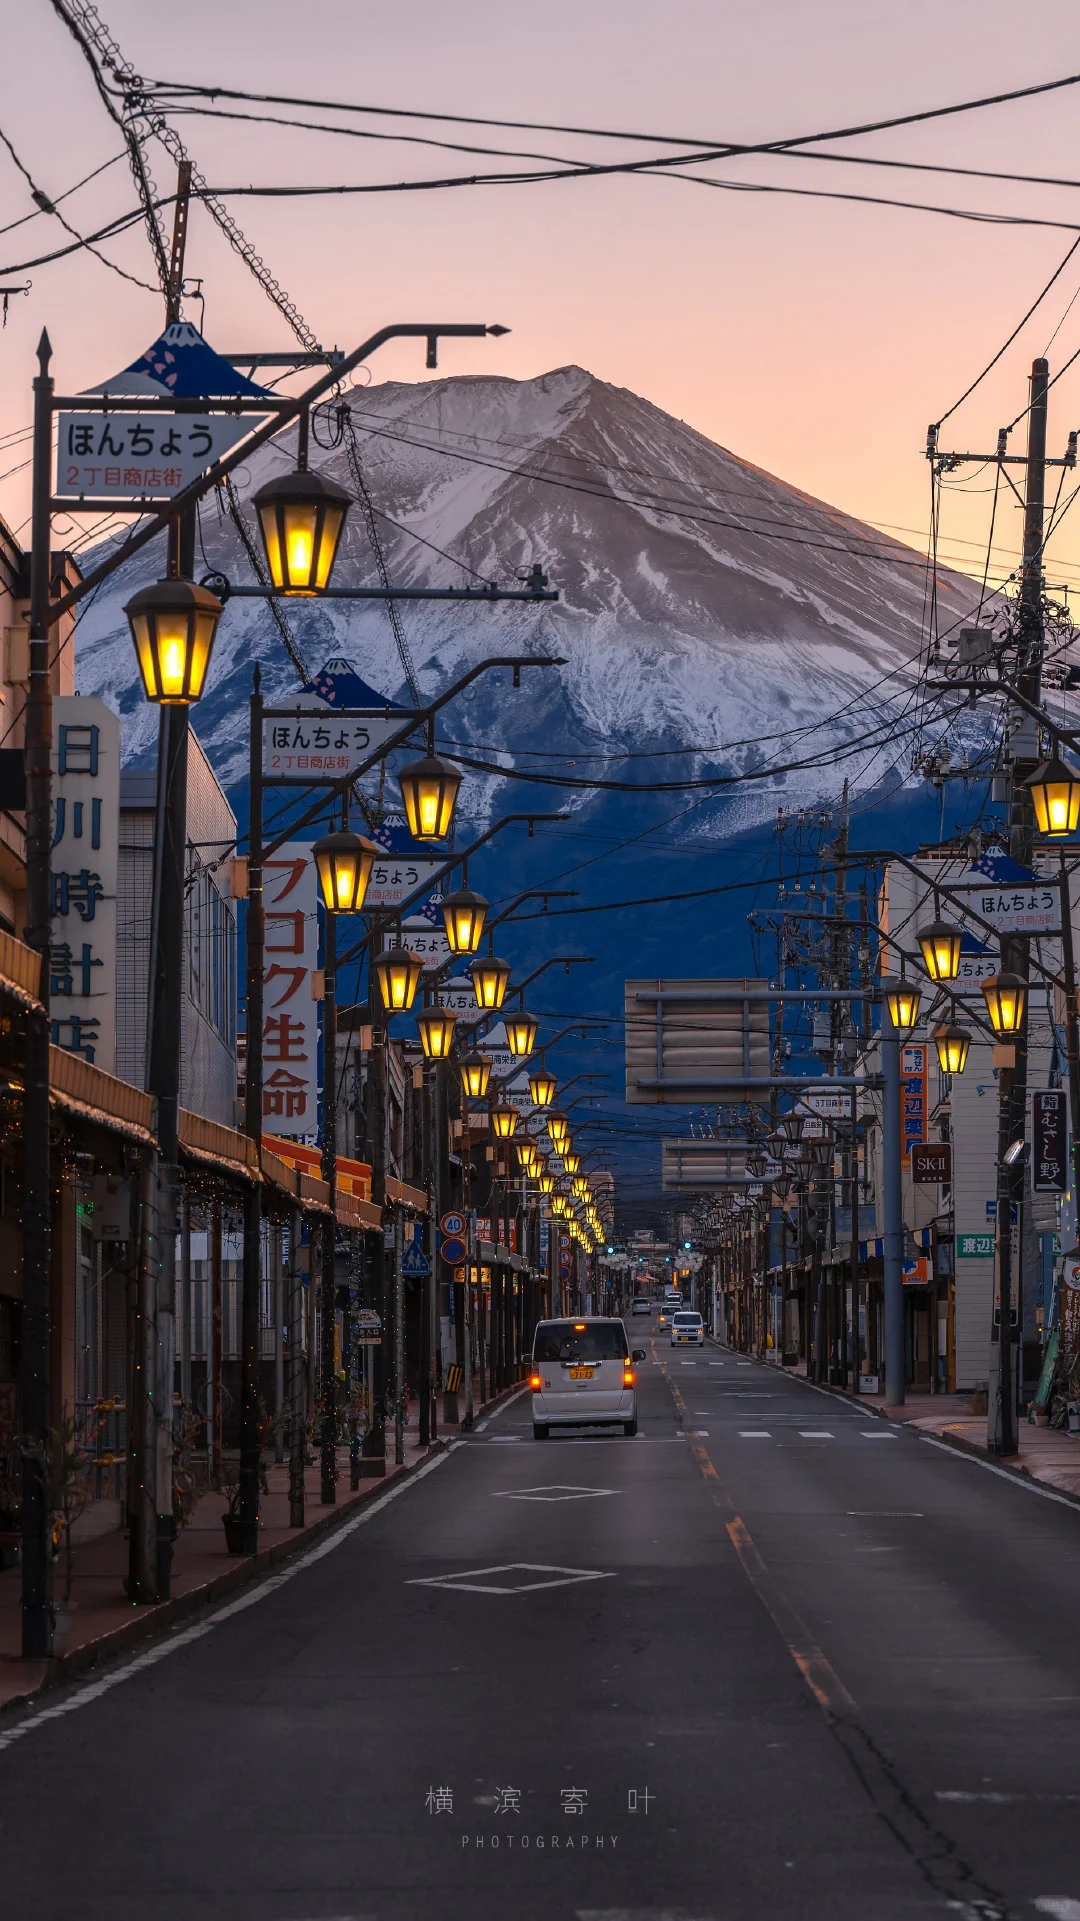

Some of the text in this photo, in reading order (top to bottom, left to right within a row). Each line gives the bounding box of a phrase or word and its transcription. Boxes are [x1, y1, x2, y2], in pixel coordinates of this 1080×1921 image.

[67, 422, 214, 458] ほんちょう
[66, 466, 183, 489] 2丁目商店街
[271, 726, 371, 750] ほんちょう
[271, 755, 351, 770] 2丁目商店街
[368, 866, 419, 885] ちょう
[982, 893, 1054, 913] ほんちょう
[262, 858, 309, 1117] フコク生命
[446, 1219, 461, 1231] 40
